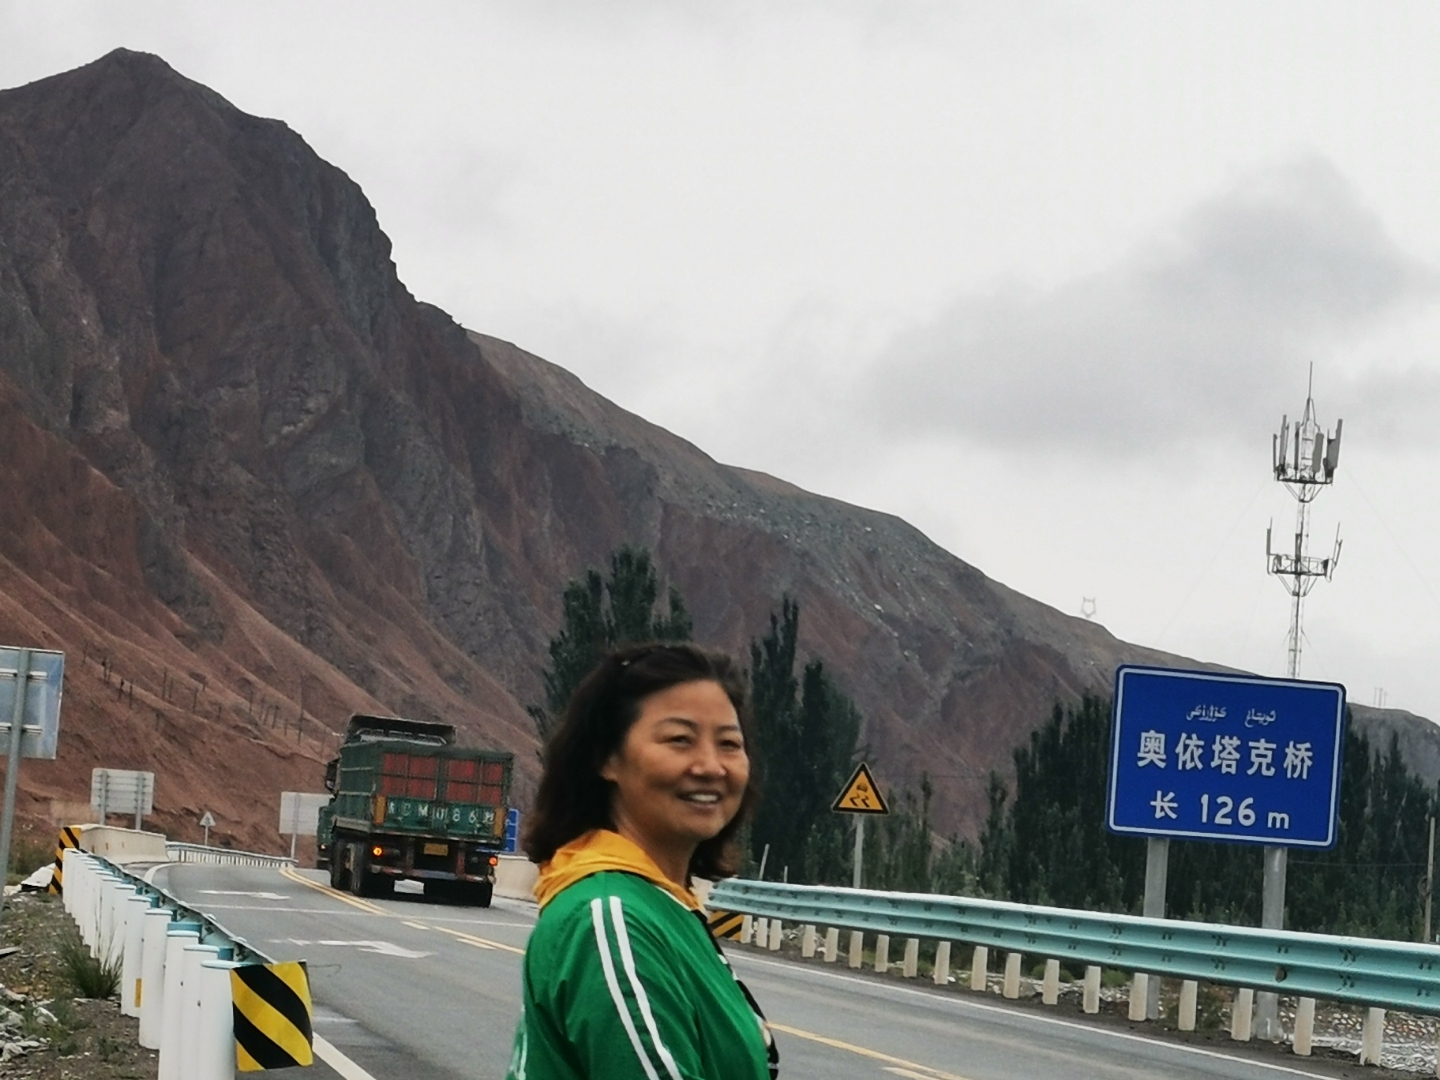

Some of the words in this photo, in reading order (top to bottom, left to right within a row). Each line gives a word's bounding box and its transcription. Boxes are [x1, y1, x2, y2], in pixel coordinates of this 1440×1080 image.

[1137, 730, 1313, 780] 奥依塔克桥
[1150, 790, 1178, 819] 长
[1200, 794, 1256, 826] 126
[1267, 811, 1289, 830] m
